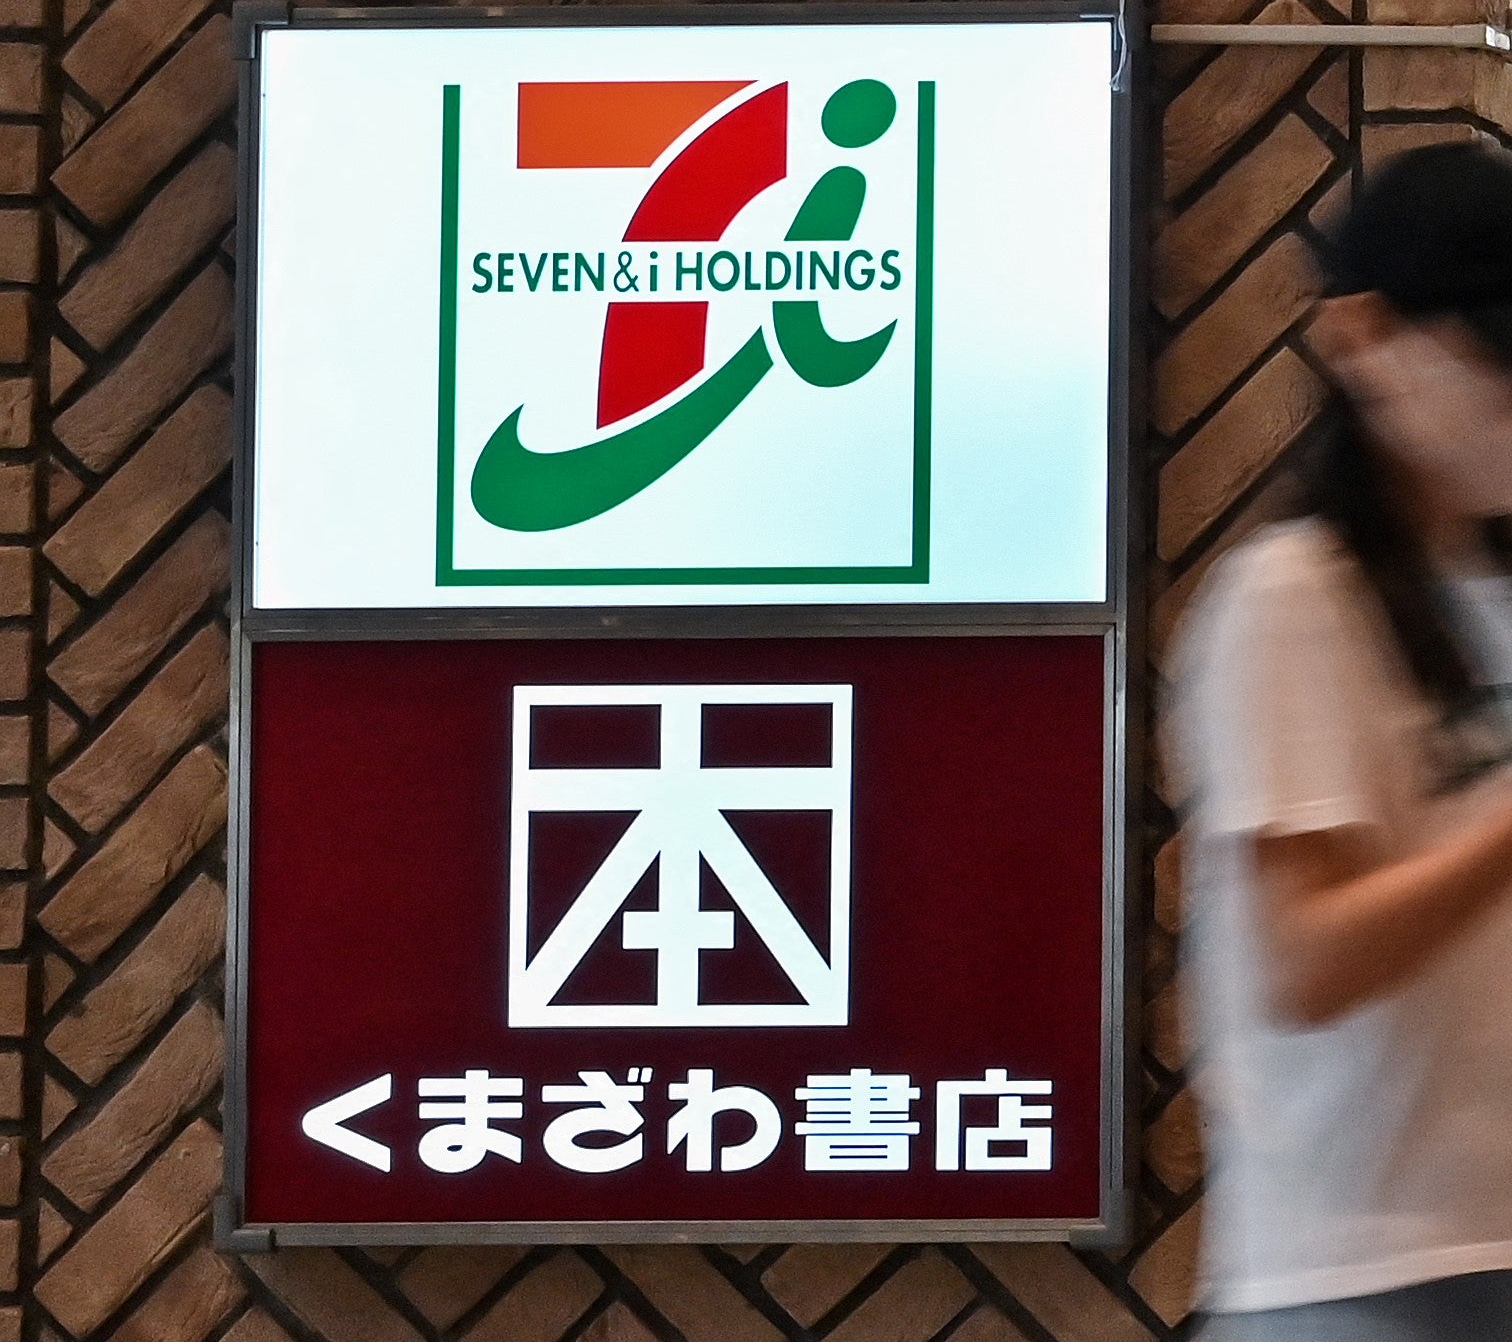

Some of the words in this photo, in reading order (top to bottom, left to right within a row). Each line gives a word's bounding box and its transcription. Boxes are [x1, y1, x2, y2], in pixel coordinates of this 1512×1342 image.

[675, 249, 902, 293] HOLDINGS
[300, 1067, 1053, 1174] くまざわ書店
